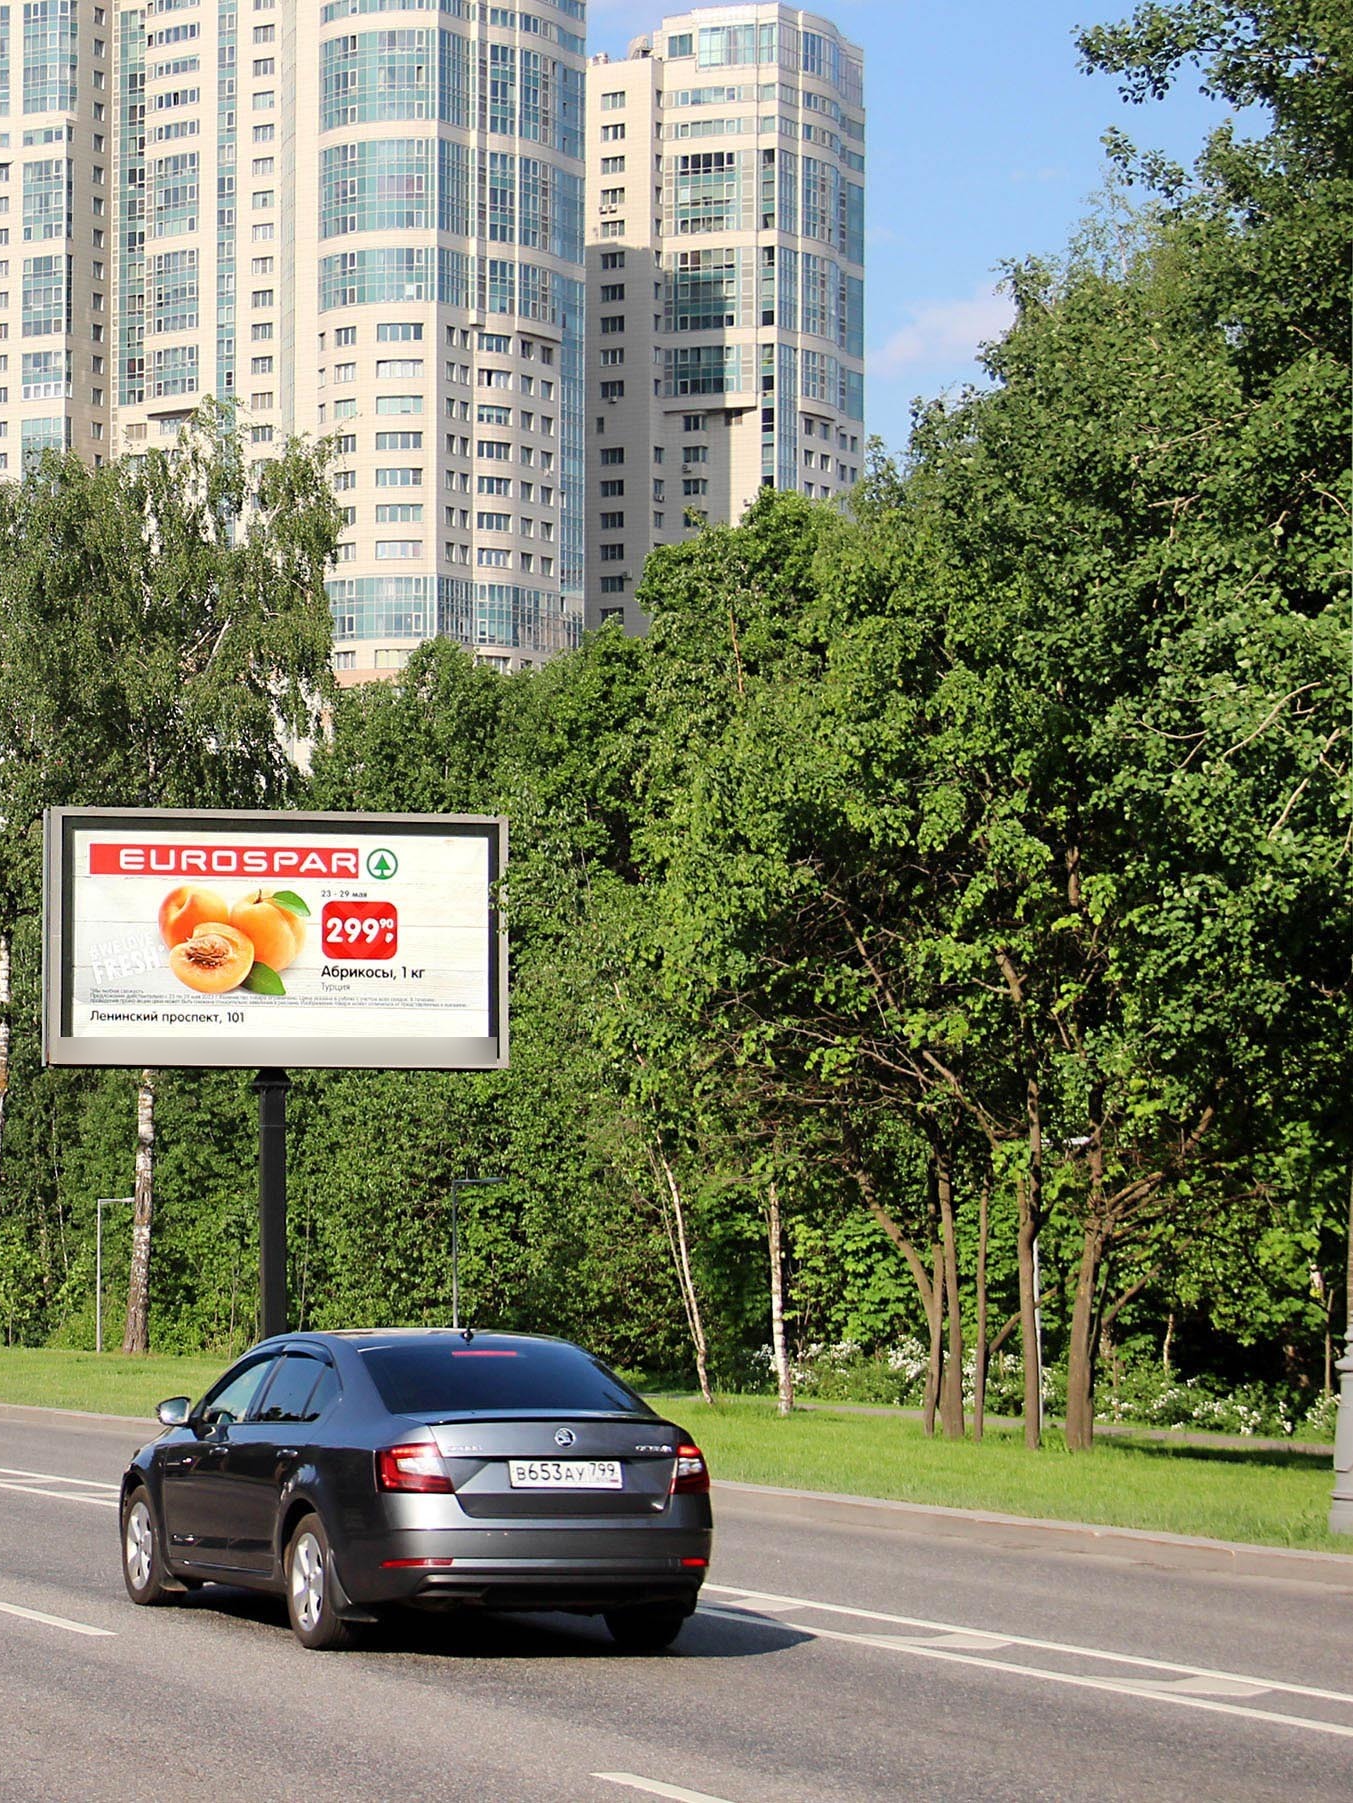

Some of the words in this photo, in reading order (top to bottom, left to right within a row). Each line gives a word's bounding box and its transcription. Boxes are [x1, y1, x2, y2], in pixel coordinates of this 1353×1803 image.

[119, 848, 357, 874] EUROSPAR
[321, 890, 332, 898] 23
[340, 890, 350, 898] 29
[326, 917, 380, 944] 299
[321, 965, 397, 981] Абрикосы,
[401, 966, 407, 978] 1
[411, 969, 426, 979] кг
[321, 982, 351, 991] Турция
[90, 1010, 158, 1022] Ленинский
[162, 1012, 223, 1025] проспект,
[228, 1012, 244, 1023] 101
[589, 1462, 615, 1477] 799
